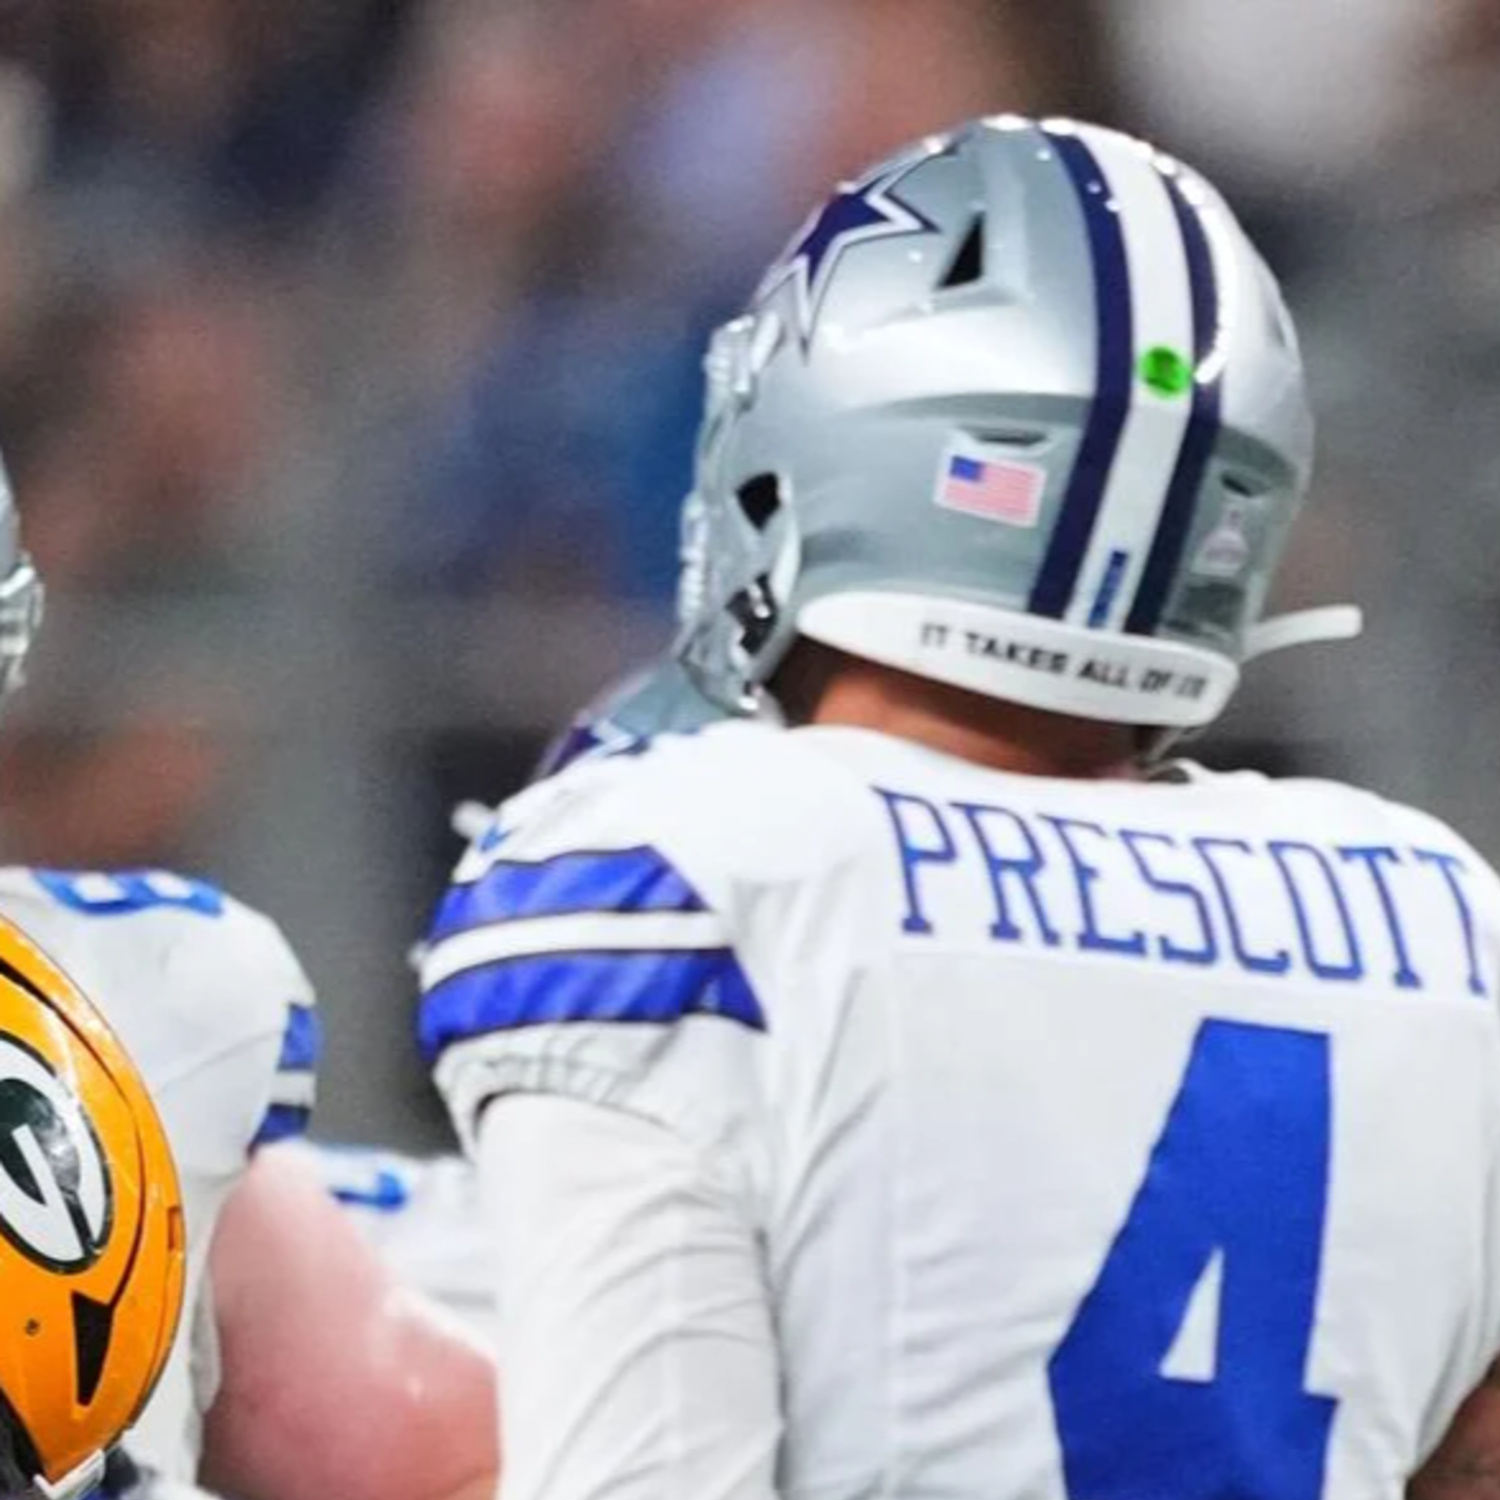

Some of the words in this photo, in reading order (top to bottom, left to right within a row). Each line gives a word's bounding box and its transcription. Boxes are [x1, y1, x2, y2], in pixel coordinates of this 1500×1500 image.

[921, 622, 947, 648] IT
[965, 631, 1067, 674] TAKES
[1077, 659, 1128, 687] ALL
[870, 785, 1487, 997] PRESCOTT
